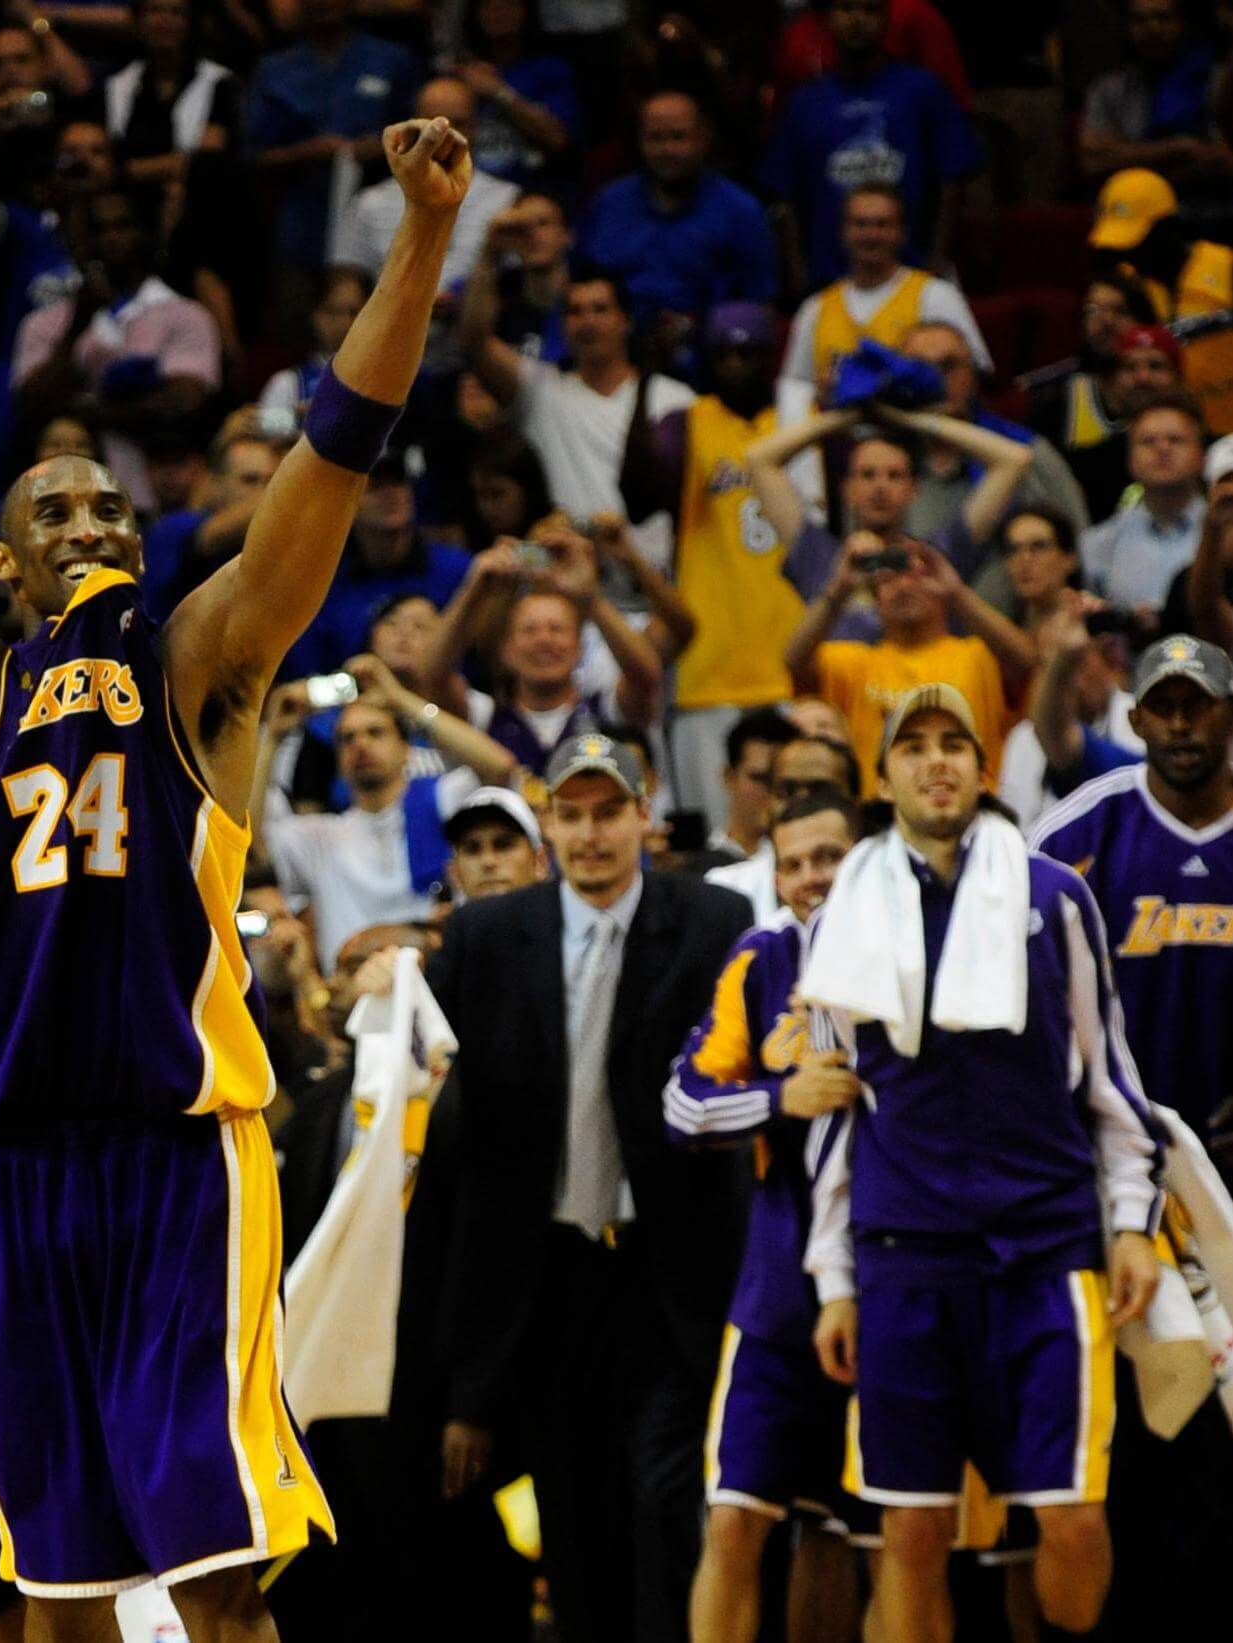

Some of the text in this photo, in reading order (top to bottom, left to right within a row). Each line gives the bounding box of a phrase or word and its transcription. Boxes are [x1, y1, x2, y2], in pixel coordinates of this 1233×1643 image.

[17, 657, 145, 736] KERS
[0, 751, 130, 895] 24
[1115, 894, 1233, 958] LAKE
